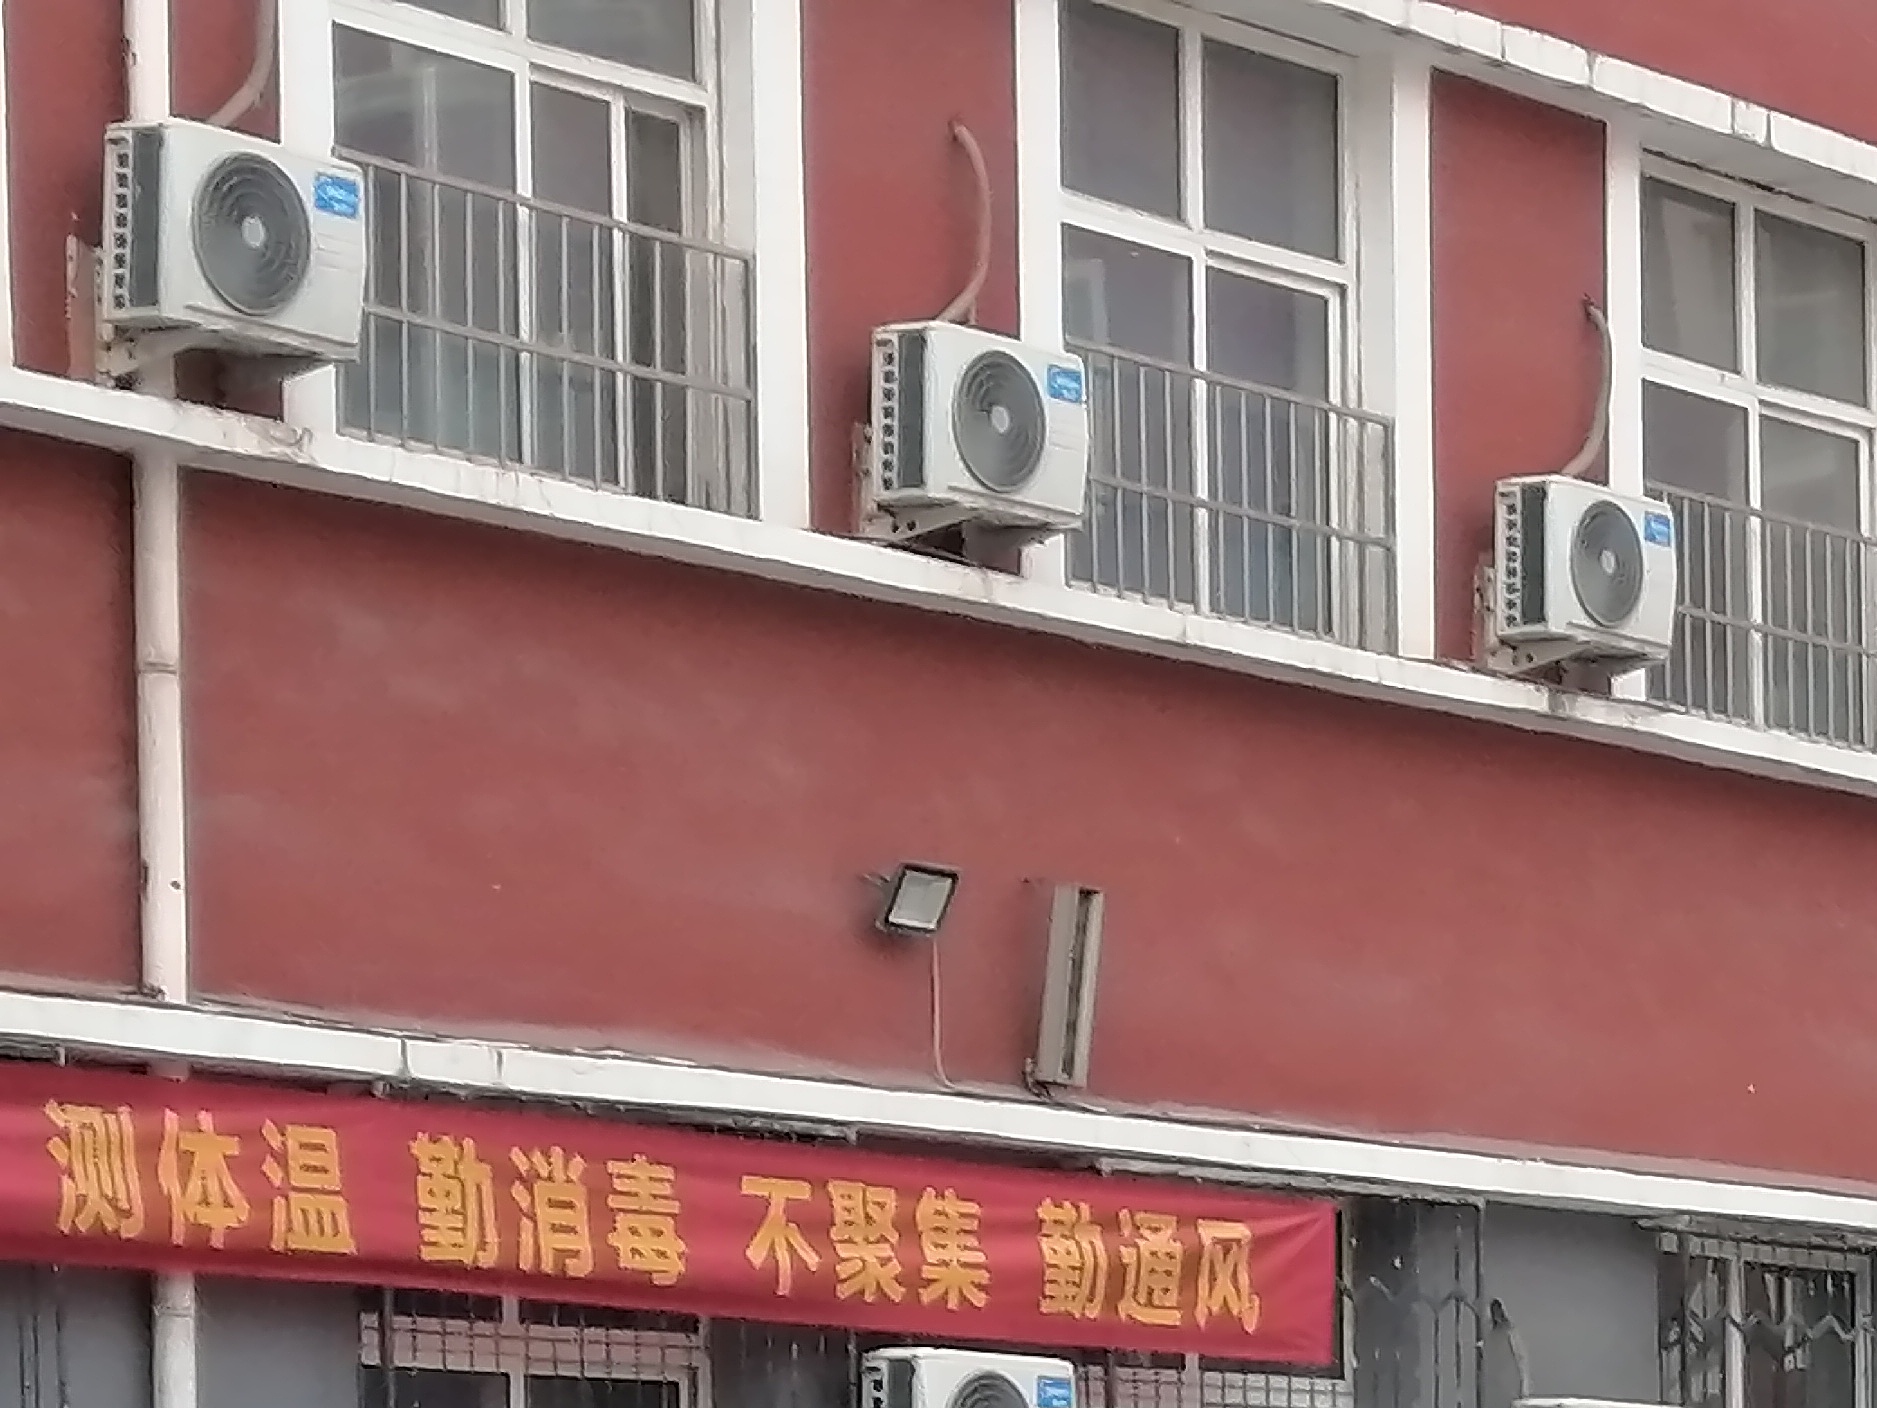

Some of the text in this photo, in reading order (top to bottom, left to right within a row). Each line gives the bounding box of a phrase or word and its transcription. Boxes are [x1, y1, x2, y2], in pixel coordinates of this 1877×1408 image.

[45, 1099, 1261, 1335] 测体温 勤消毒 不聚集 勤通风
